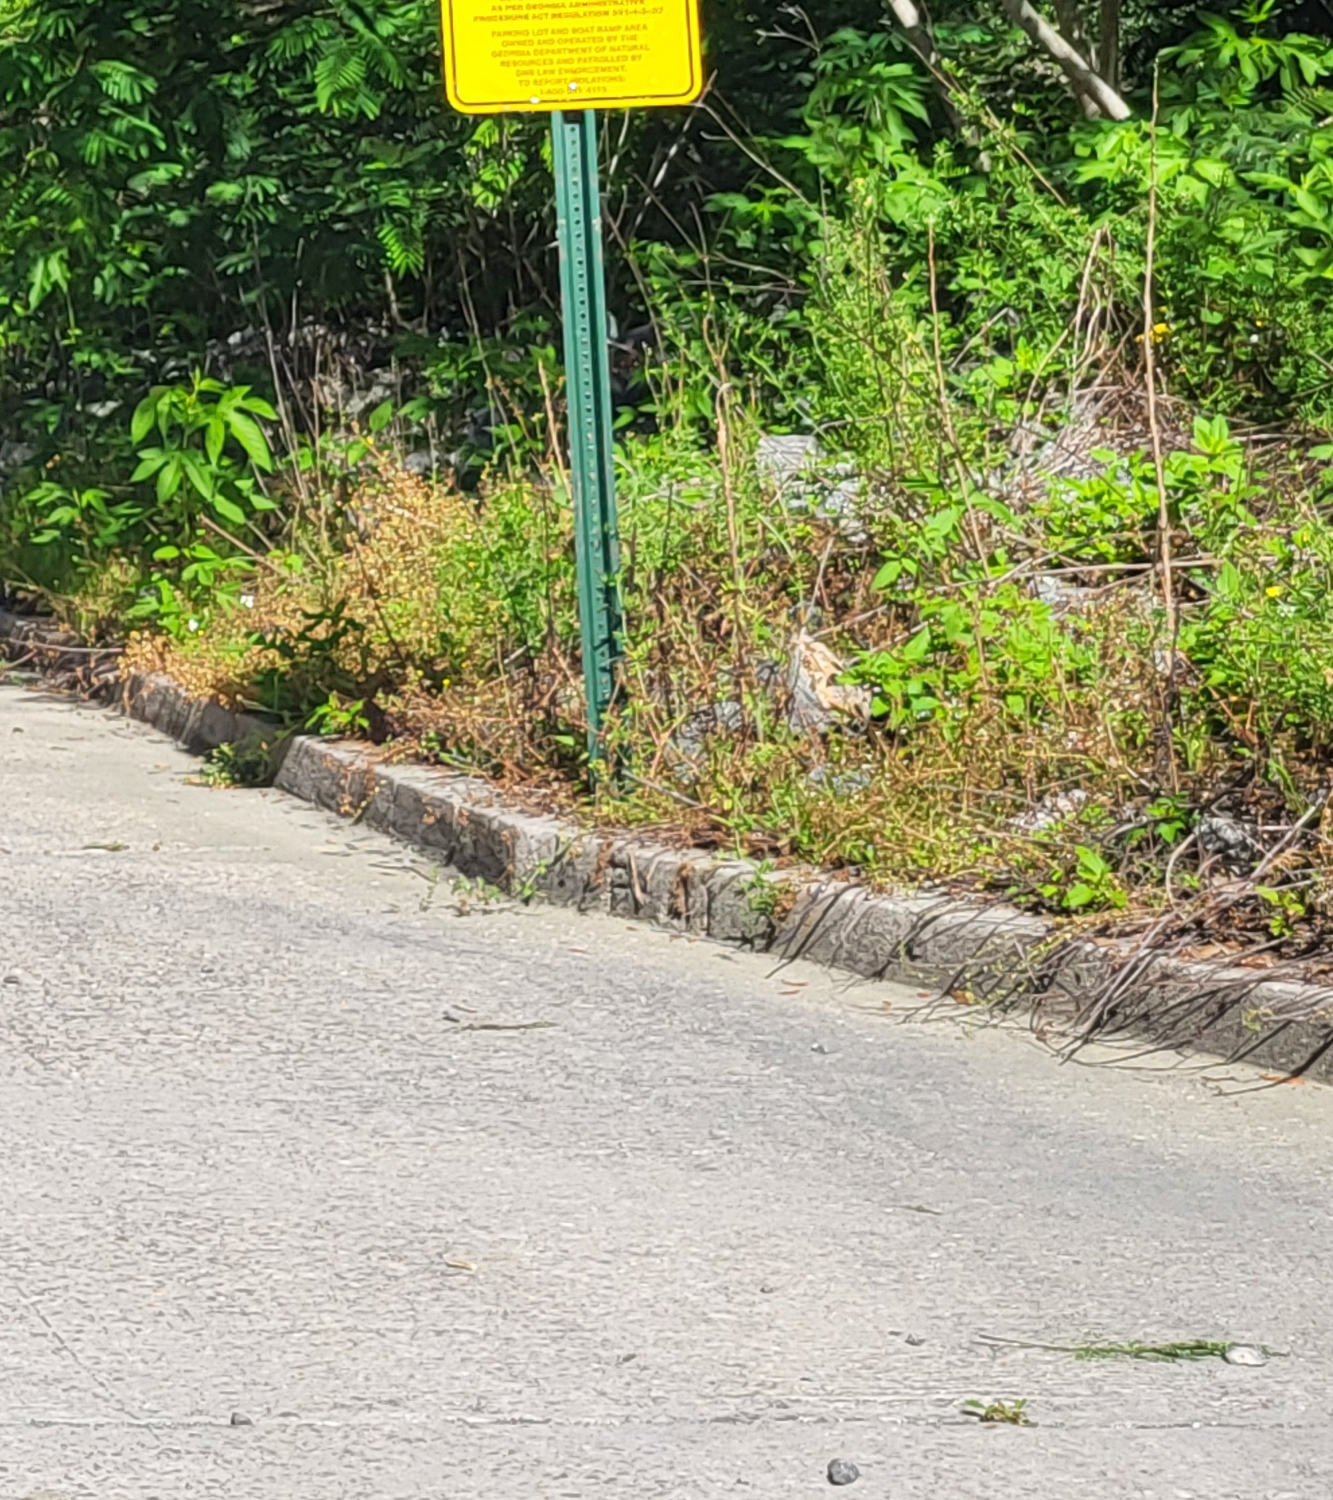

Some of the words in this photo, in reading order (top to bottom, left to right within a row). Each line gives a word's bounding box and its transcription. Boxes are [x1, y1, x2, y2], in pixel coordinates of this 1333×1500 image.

[491, 4, 503, 12] AS
[491, 29, 529, 37] PARKING
[532, 28, 549, 36] LOT
[571, 26, 595, 34] BOAT
[596, 25, 622, 33] RAMP
[624, 23, 648, 32] AREA
[501, 39, 534, 47] OWNED
[557, 36, 604, 45] OPERATED
[606, 35, 618, 43] BY
[620, 34, 638, 42] THE
[491, 50, 531, 58] GEORGIA
[533, 47, 592, 56] DEPARTMENT
[594, 45, 607, 53] OF
[609, 43, 650, 52] NATURAL
[556, 57, 575, 65] AND
[630, 53, 643, 61] BY
[518, 79, 531, 87] TO
